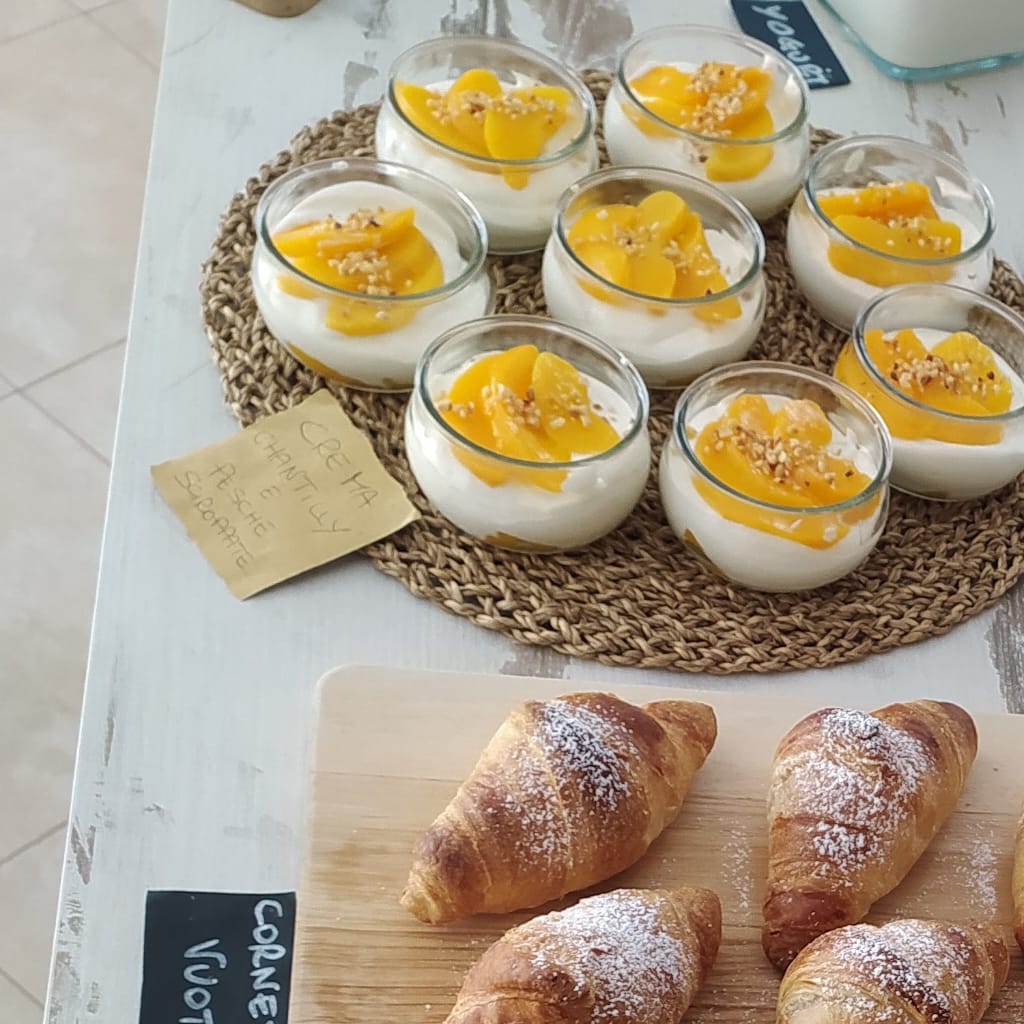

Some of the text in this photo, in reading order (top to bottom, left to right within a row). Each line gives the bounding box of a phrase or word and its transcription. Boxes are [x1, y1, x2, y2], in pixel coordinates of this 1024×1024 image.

[208, 463, 276, 538] PESCHE
[253, 431, 352, 533] CHANTILLY
[300, 420, 379, 508] CREMA
